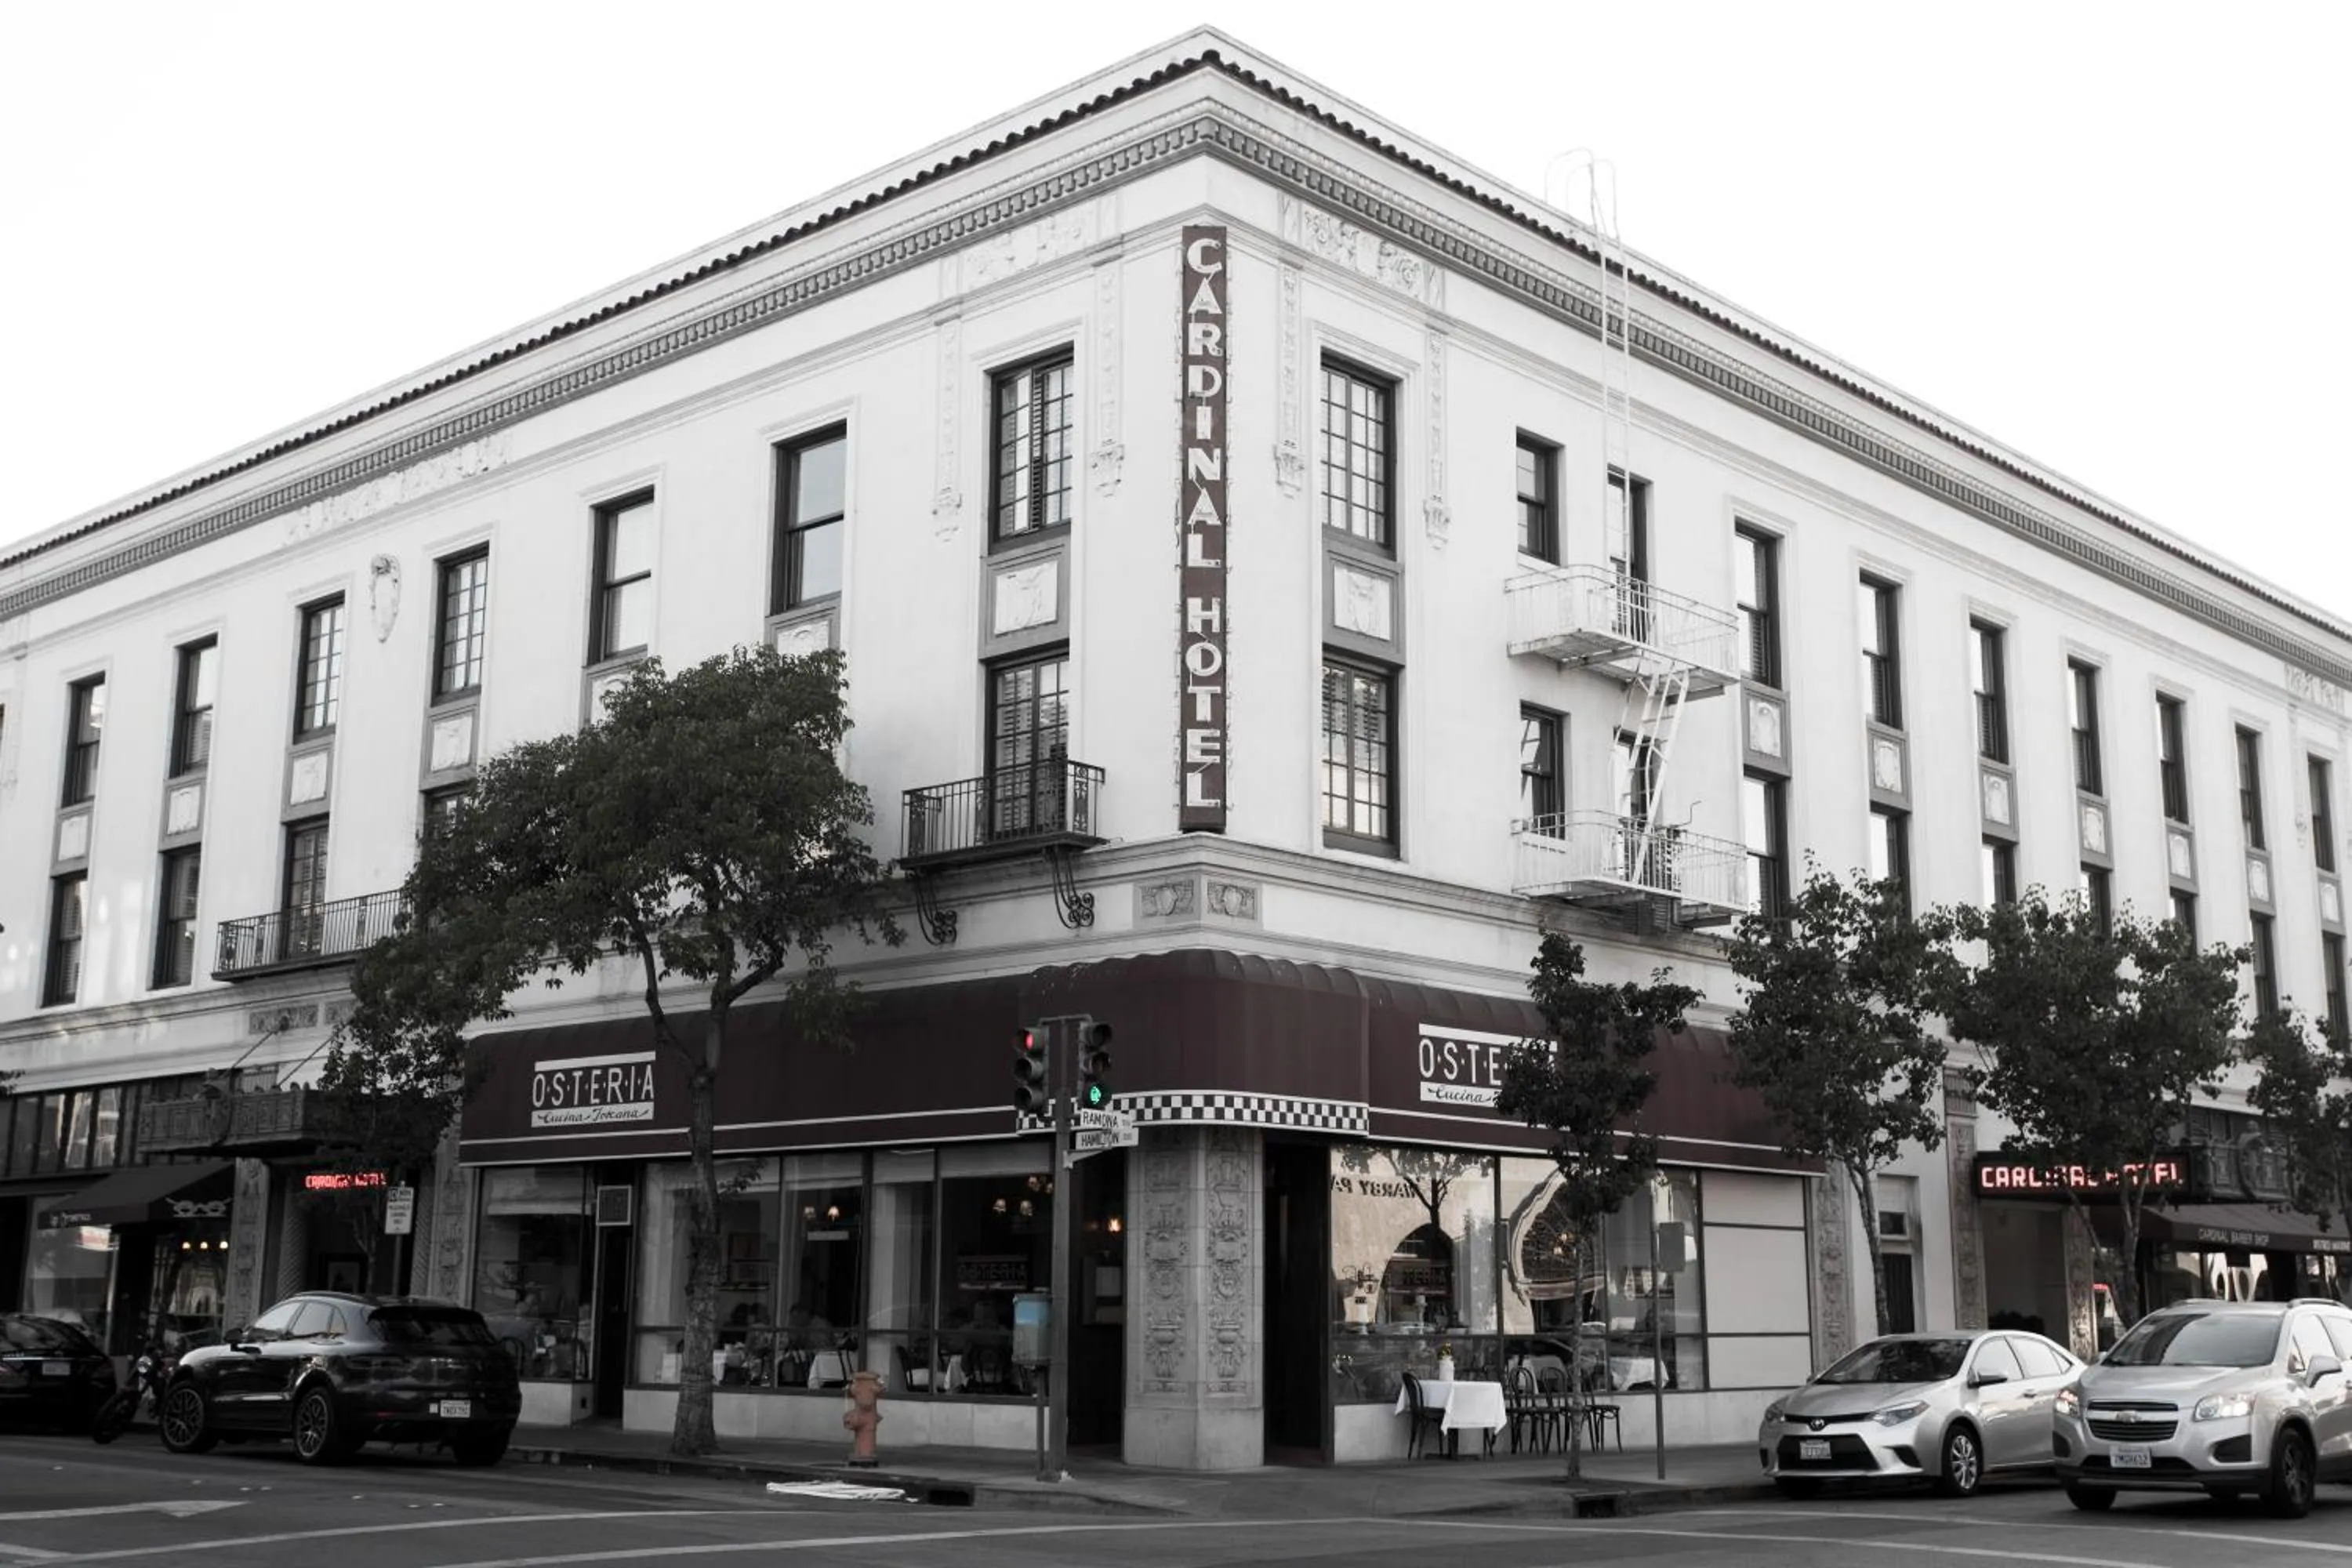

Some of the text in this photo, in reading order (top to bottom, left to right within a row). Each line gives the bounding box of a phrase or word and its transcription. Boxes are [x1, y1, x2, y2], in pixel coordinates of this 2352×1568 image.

[1185, 238, 1223, 808] CARDINAL HOTEL
[1083, 1111, 1120, 1128] RAMONA
[1082, 1131, 1120, 1147] HAMILTON
